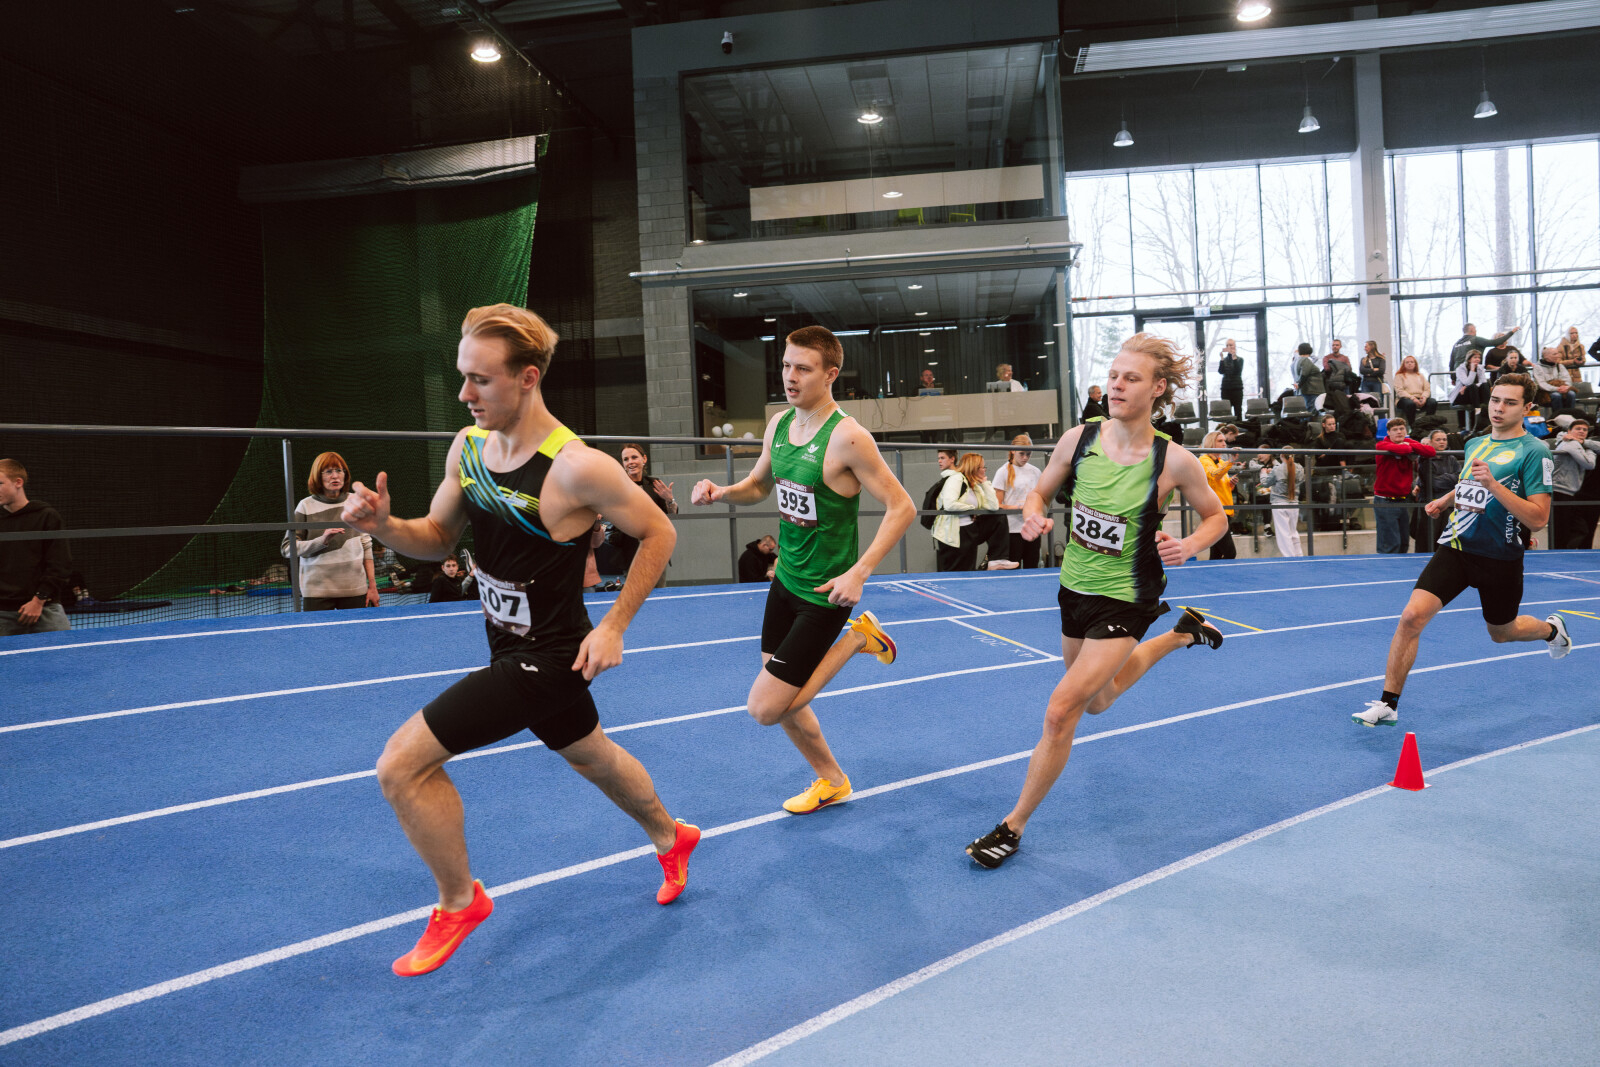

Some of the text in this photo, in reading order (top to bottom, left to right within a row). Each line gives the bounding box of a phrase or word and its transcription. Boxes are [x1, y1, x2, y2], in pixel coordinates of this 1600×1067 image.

[780, 488, 810, 515] 393
[1456, 485, 1486, 505] 440
[1075, 513, 1120, 545] 284
[971, 634, 1009, 647] 200
